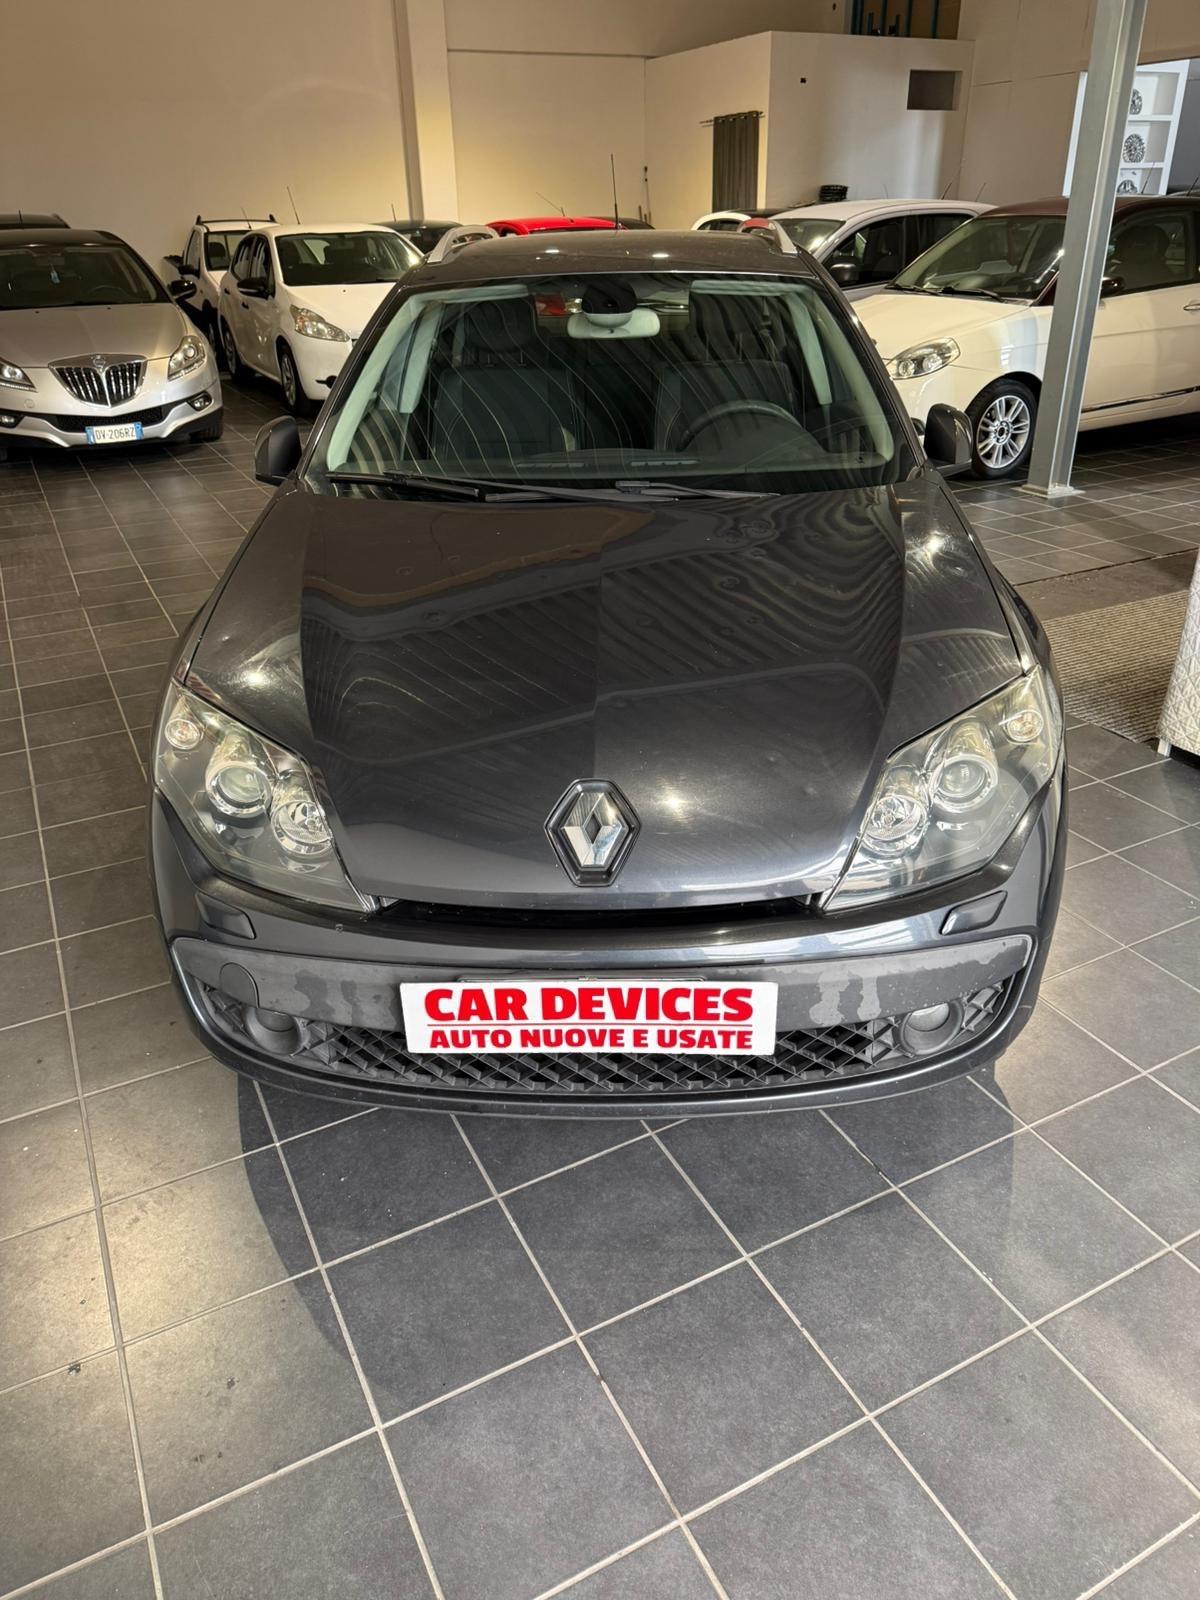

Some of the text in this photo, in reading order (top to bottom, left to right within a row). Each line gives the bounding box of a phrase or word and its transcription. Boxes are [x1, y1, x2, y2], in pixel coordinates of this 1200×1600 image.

[424, 987, 753, 1022] CAR DEVICES
[430, 1028, 752, 1049] AUTO NUOVE E USATE
